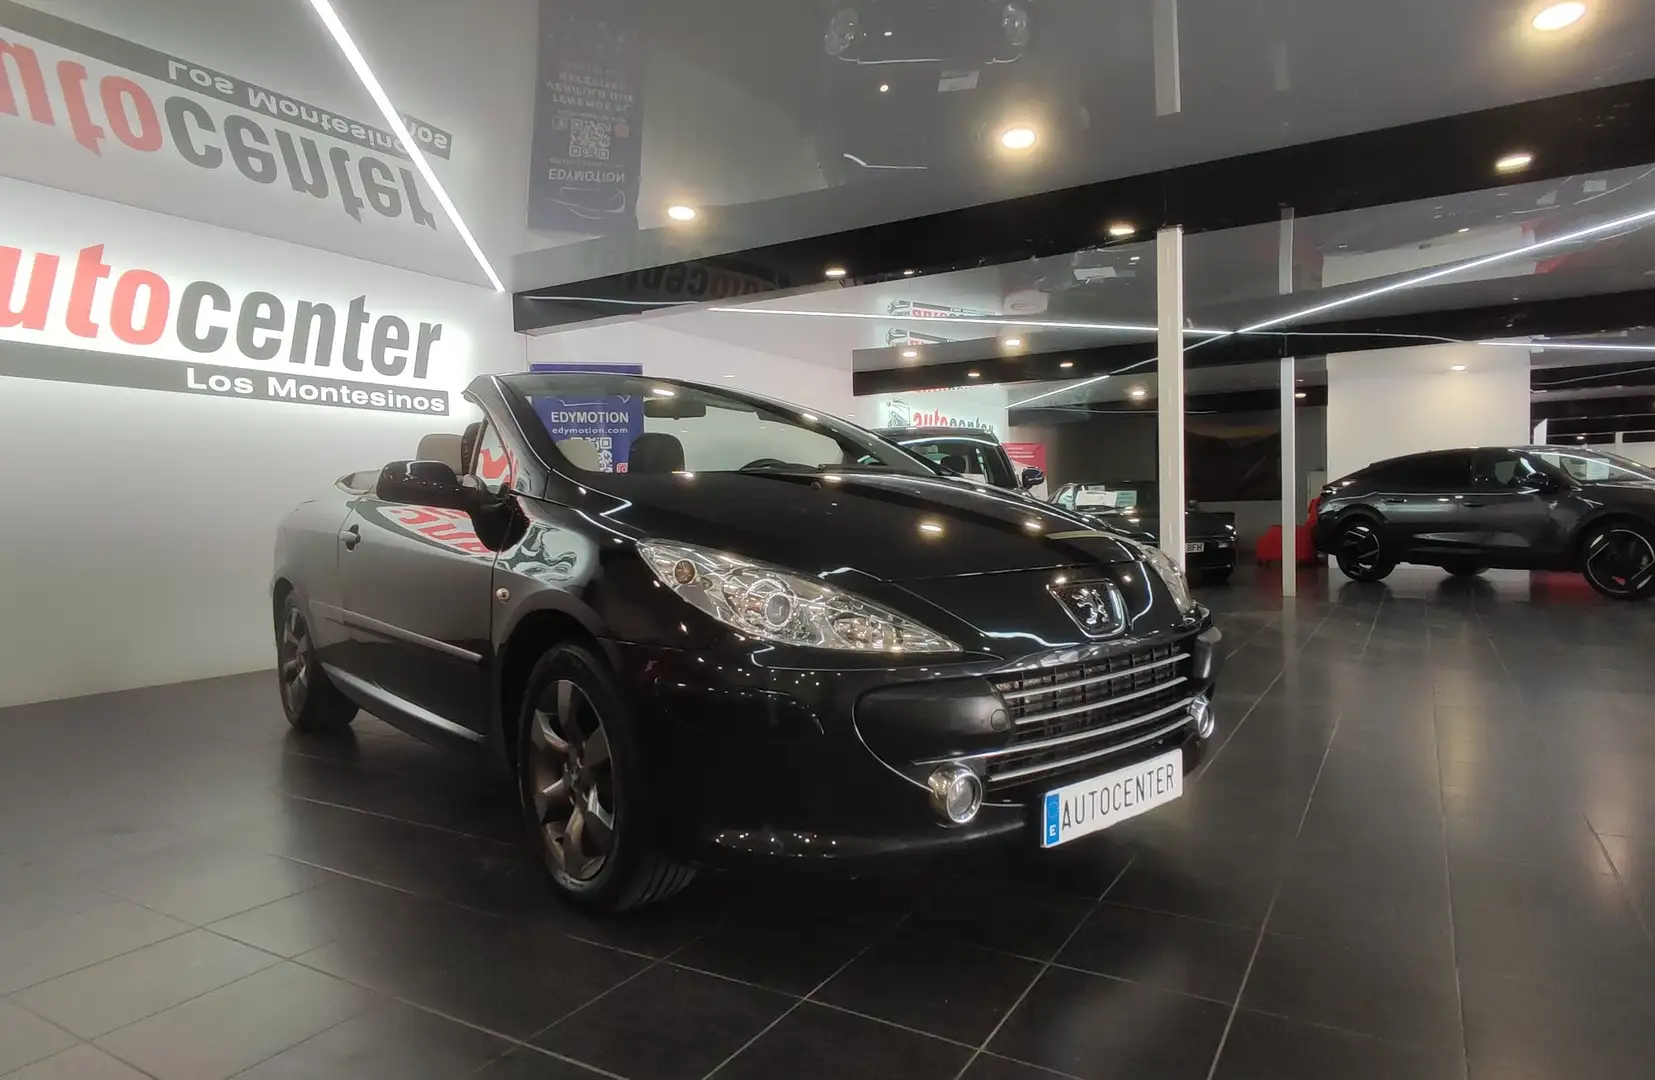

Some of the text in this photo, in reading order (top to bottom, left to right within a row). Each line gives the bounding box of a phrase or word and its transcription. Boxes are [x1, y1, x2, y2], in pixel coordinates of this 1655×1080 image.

[0, 243, 443, 379] utocenter
[186, 367, 447, 412] Los Montesinos
[550, 411, 629, 424] EDYMOTION
[551, 426, 629, 435] edymotion.com
[1049, 763, 1174, 837] E AUTOCENTER
